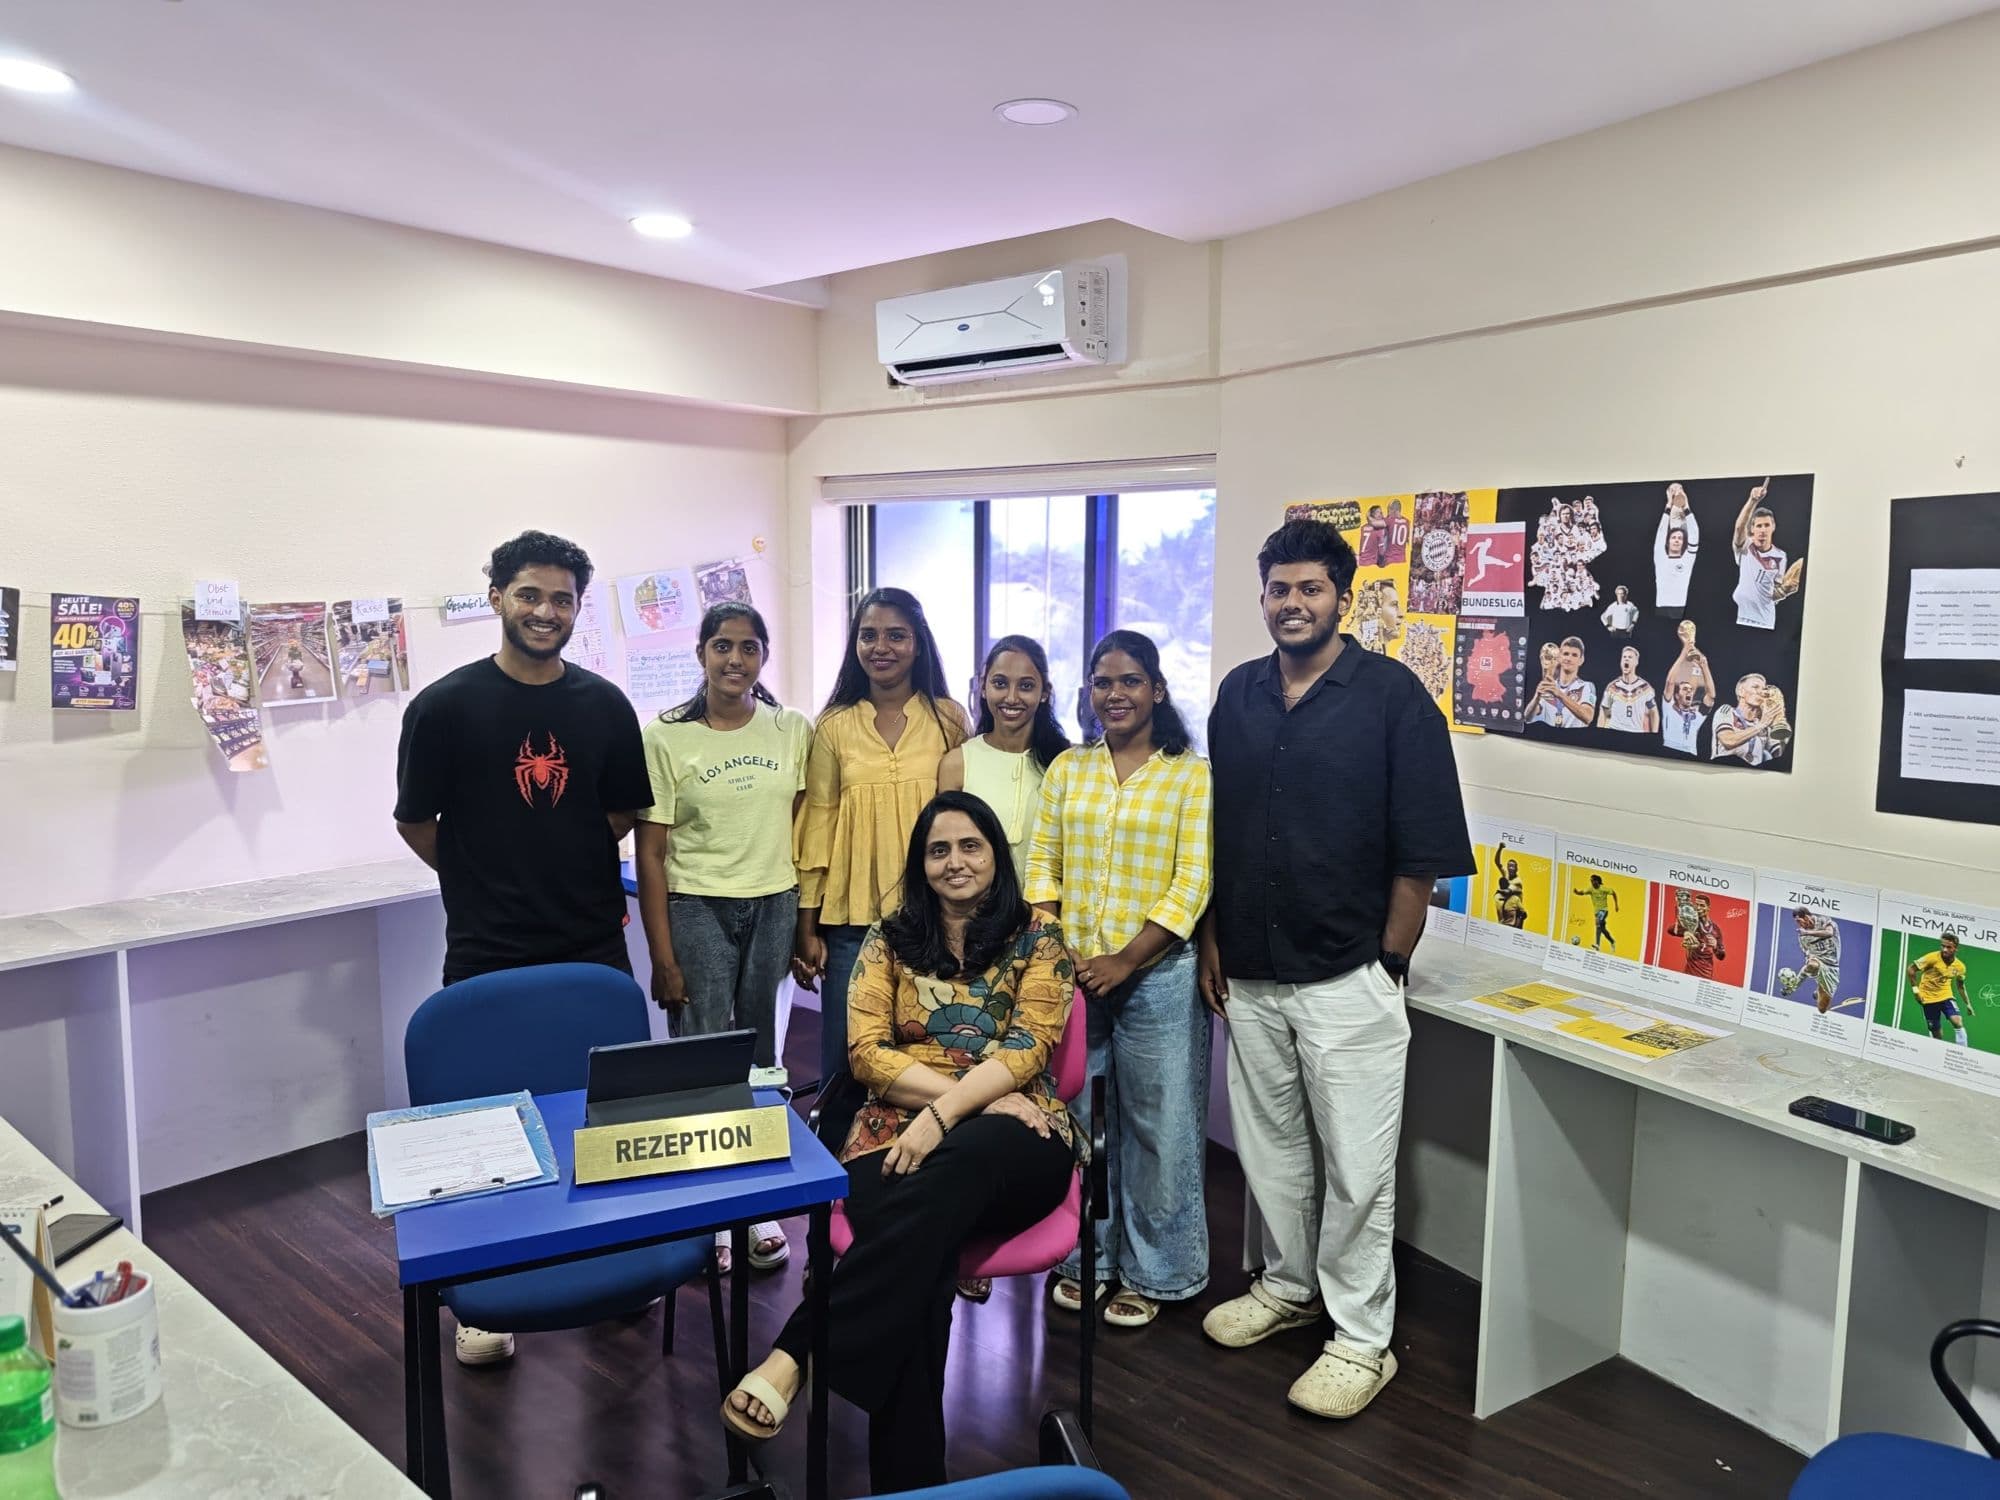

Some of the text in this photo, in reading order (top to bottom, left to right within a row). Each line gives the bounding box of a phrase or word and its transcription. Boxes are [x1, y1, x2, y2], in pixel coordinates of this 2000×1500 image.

[1361, 532, 1371, 553] 7
[1392, 524, 1408, 546] 10
[207, 584, 232, 594] Obst
[57, 603, 103, 616] SALE!
[1461, 597, 1524, 608] BUNDESLIGA
[1626, 705, 1633, 718] 6
[699, 755, 779, 784] LOS ANGELES
[1669, 869, 1730, 890] RONALDO
[1788, 891, 1841, 911] ZIDANE
[1901, 914, 1999, 943] NEYMAR JR
[615, 1124, 752, 1163] REZEPTION
